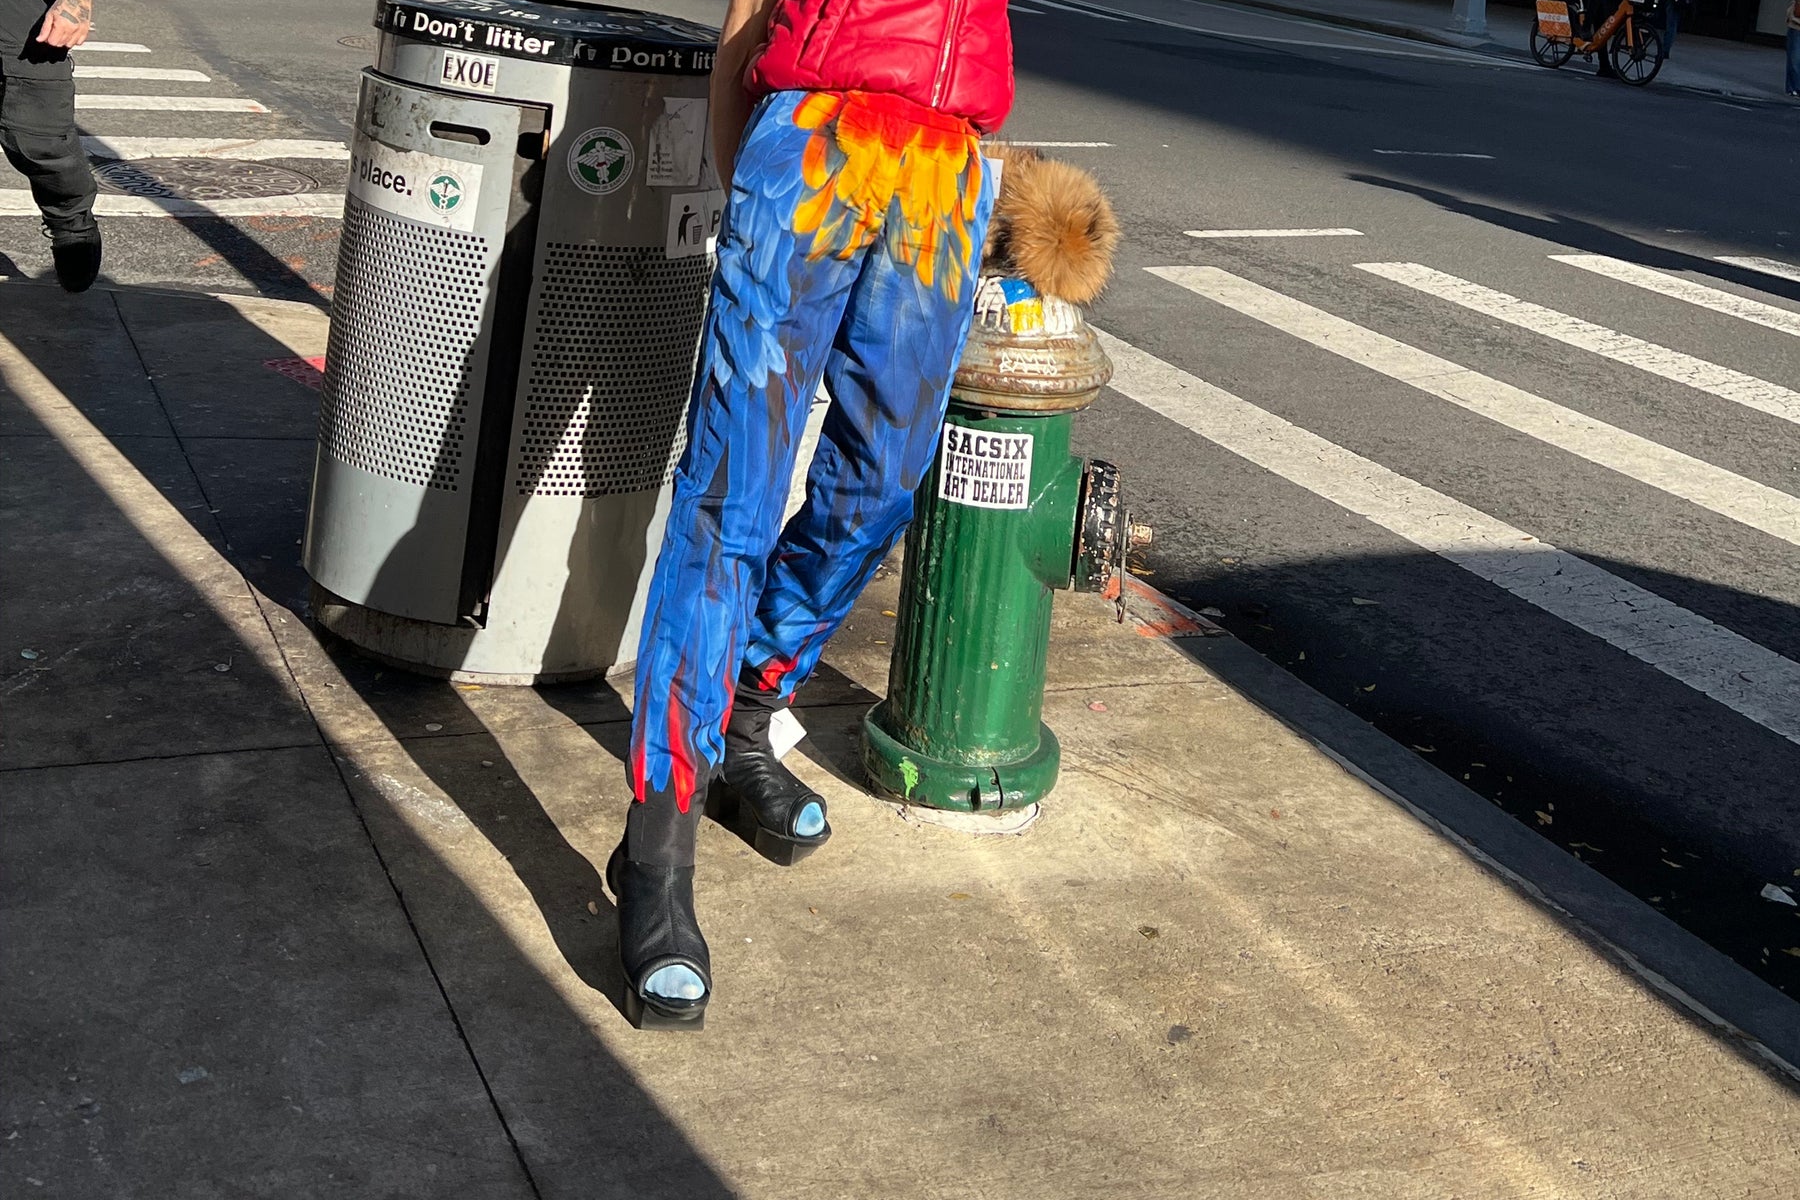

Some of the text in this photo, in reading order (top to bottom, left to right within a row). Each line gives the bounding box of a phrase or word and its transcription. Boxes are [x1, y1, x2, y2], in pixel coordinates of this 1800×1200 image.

[413, 12, 556, 56] Don't litter
[442, 56, 497, 88] EXOE
[612, 47, 718, 70] Don't litt
[360, 158, 412, 196] place.
[947, 429, 1028, 460] SACSIX
[946, 452, 1025, 480] INTERNATIONAL
[944, 473, 1024, 504] ART DEALER
